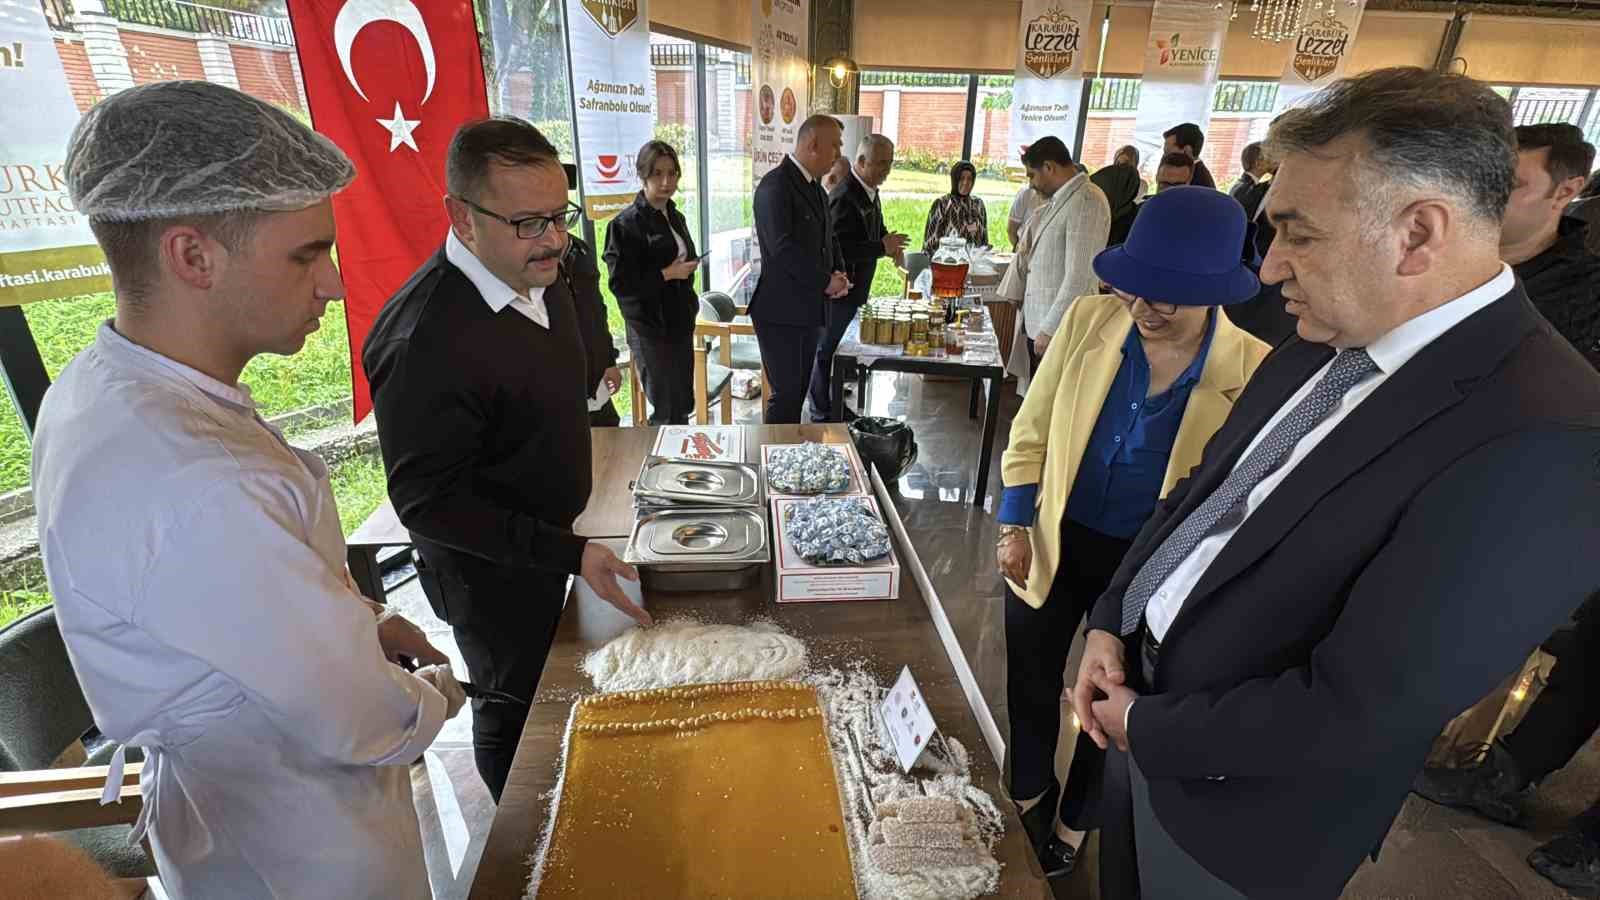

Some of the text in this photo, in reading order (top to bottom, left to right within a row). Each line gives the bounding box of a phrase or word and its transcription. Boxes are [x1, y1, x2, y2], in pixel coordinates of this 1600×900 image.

[1025, 24, 1080, 51] Lezzet
[1296, 33, 1348, 56] Lezzet
[579, 97, 627, 112] Safranbolu
